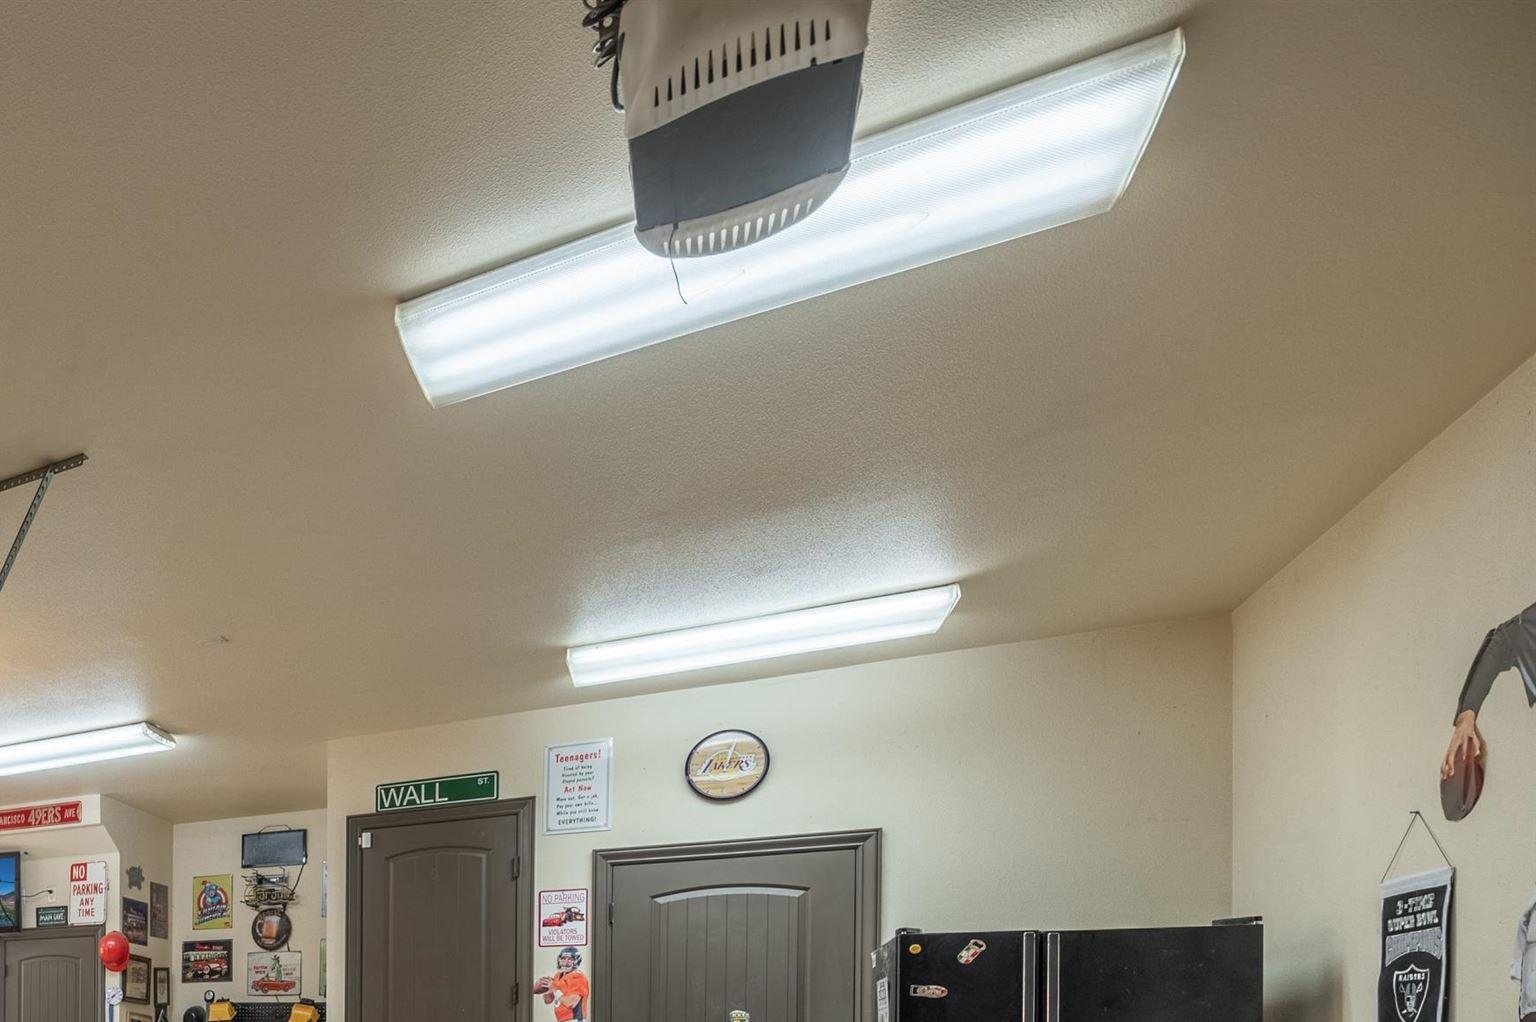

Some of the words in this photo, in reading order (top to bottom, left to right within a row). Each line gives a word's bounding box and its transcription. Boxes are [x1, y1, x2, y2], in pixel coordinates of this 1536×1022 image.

[555, 749, 601, 763] Teenagers!
[379, 782, 449, 808] WALL
[477, 777, 491, 786] ST.
[564, 786, 575, 794] Act
[28, 807, 62, 826] 49ERS
[64, 808, 76, 818] AVE
[558, 817, 597, 826] EVERYTHING!
[72, 865, 85, 880] NO
[72, 882, 104, 896] PARKING
[79, 897, 95, 907] ANY
[542, 894, 552, 904] NO
[554, 892, 585, 904] PARKING
[78, 908, 96, 917] TIME
[1387, 914, 1416, 932] SUPER
[1416, 909, 1440, 927] BOWL
[564, 934, 584, 942] TOWED
[1398, 972, 1426, 982] RAIDERS
